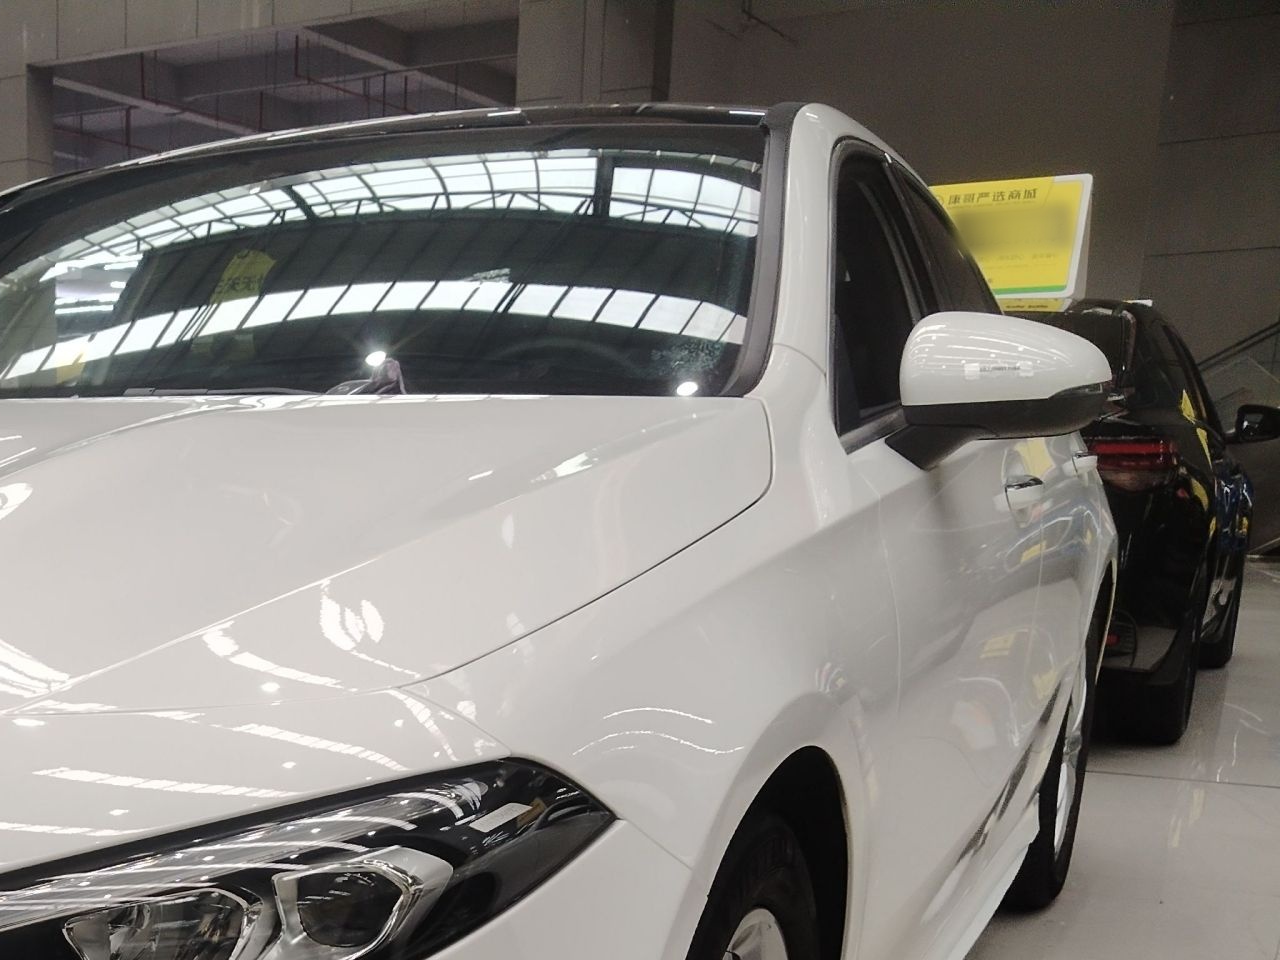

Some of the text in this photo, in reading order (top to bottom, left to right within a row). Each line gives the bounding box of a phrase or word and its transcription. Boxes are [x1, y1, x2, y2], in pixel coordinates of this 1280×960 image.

[948, 189, 1037, 204] 康哥严选商城
